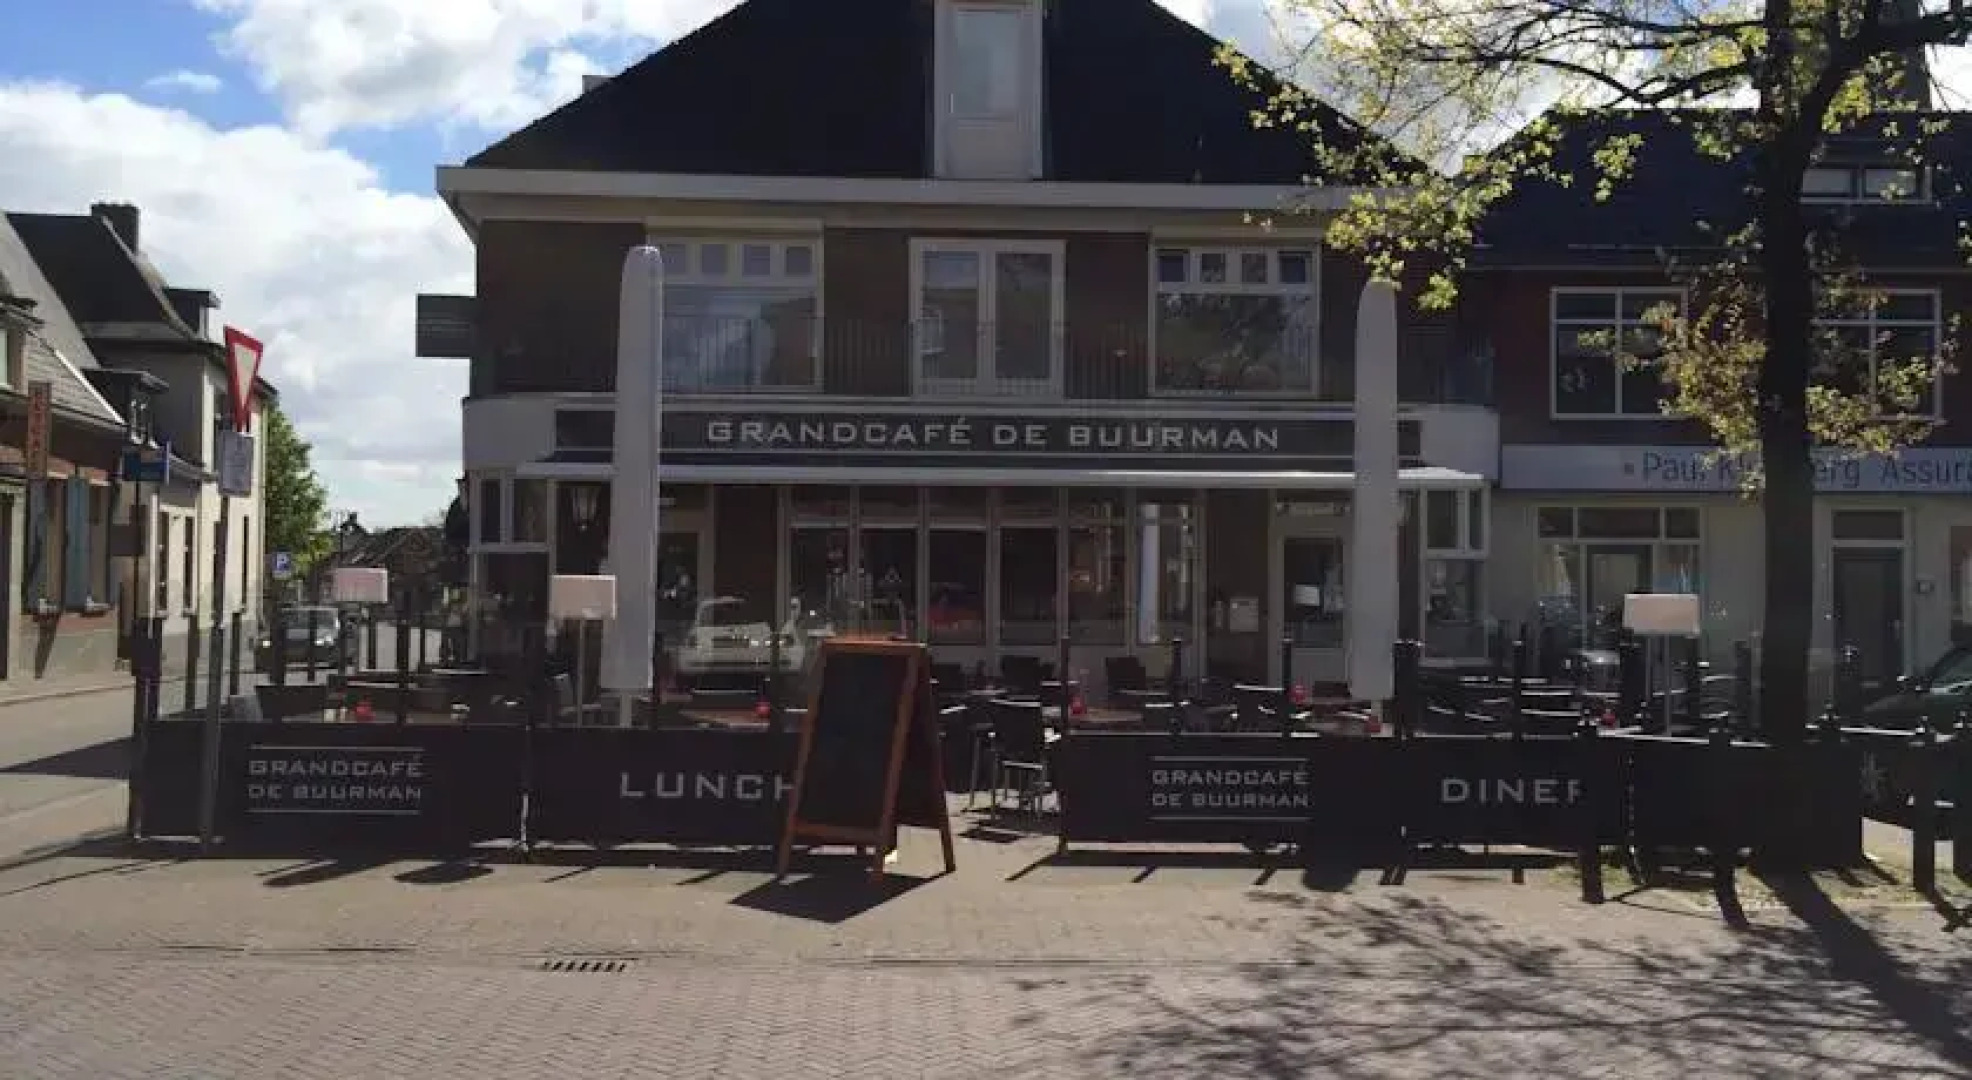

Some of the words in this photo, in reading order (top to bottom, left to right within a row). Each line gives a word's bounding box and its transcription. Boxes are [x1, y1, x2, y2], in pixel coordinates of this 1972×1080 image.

[707, 417, 971, 445] GRANDCAFÉ
[994, 424, 1046, 446] DE
[1070, 425, 1279, 449] BUURMAN
[248, 752, 424, 776] GRANDCAFÉ
[1151, 762, 1310, 785] GRANDCAFÉ
[248, 785, 282, 800] DE
[293, 785, 421, 801] BUURMAN
[1151, 792, 1184, 807] DE
[1191, 792, 1309, 808] BUURMAN
